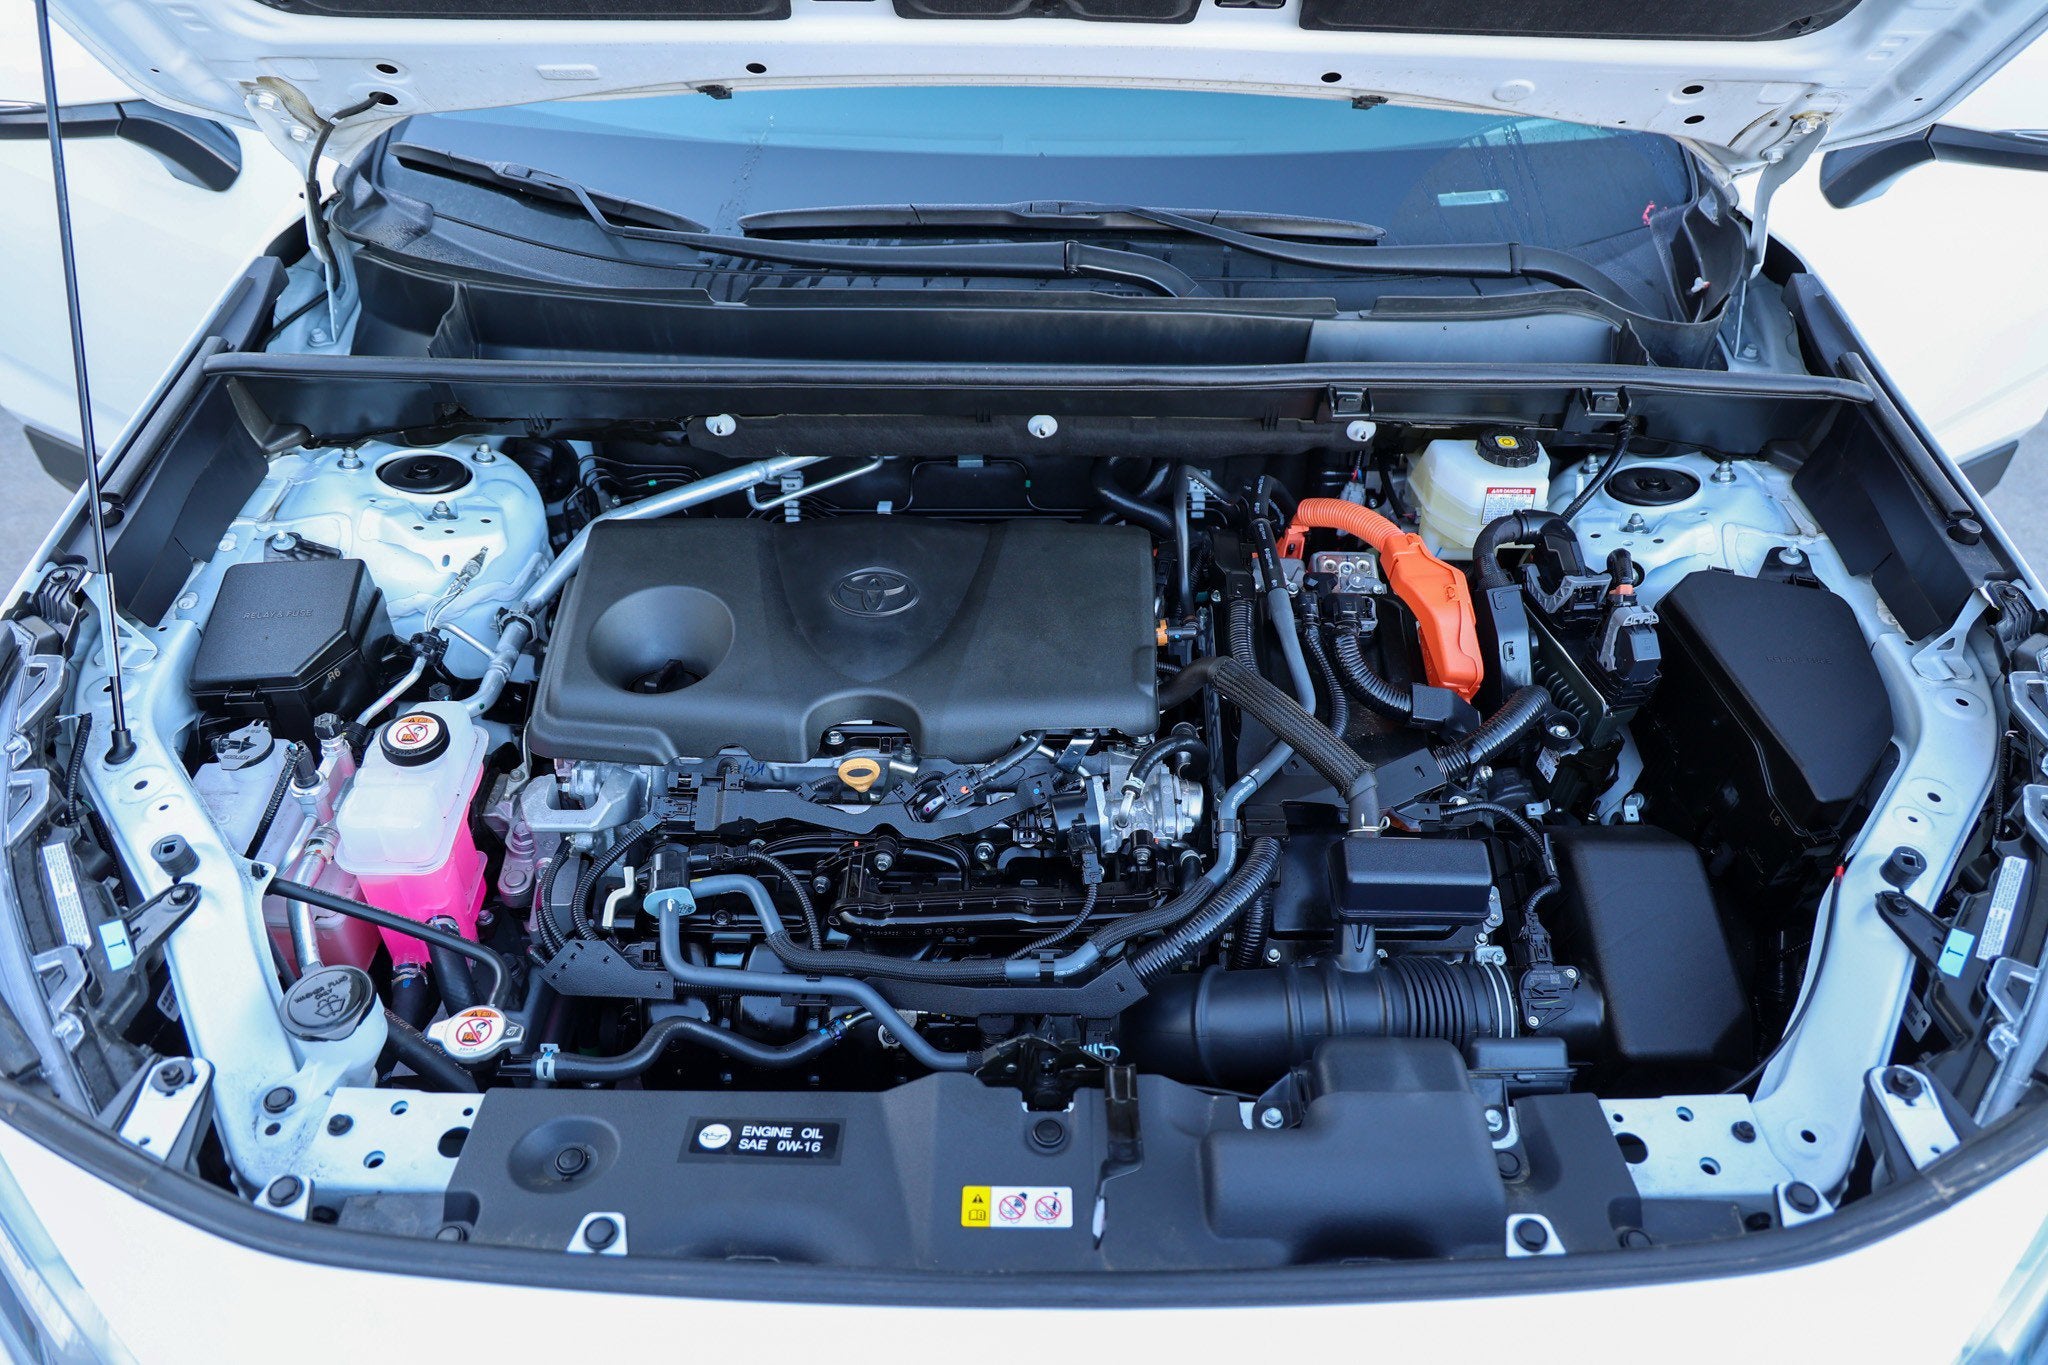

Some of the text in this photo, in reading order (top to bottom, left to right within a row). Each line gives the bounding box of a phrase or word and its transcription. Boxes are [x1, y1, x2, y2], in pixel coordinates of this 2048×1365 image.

[286, 609, 313, 618] FUSE
[327, 668, 341, 682] R6
[1770, 808, 1781, 826] L6
[109, 939, 126, 948] T
[1946, 946, 1964, 957] T
[741, 1125, 824, 1139] ENGINE OIL
[738, 1138, 821, 1153] SAE 0W-16
